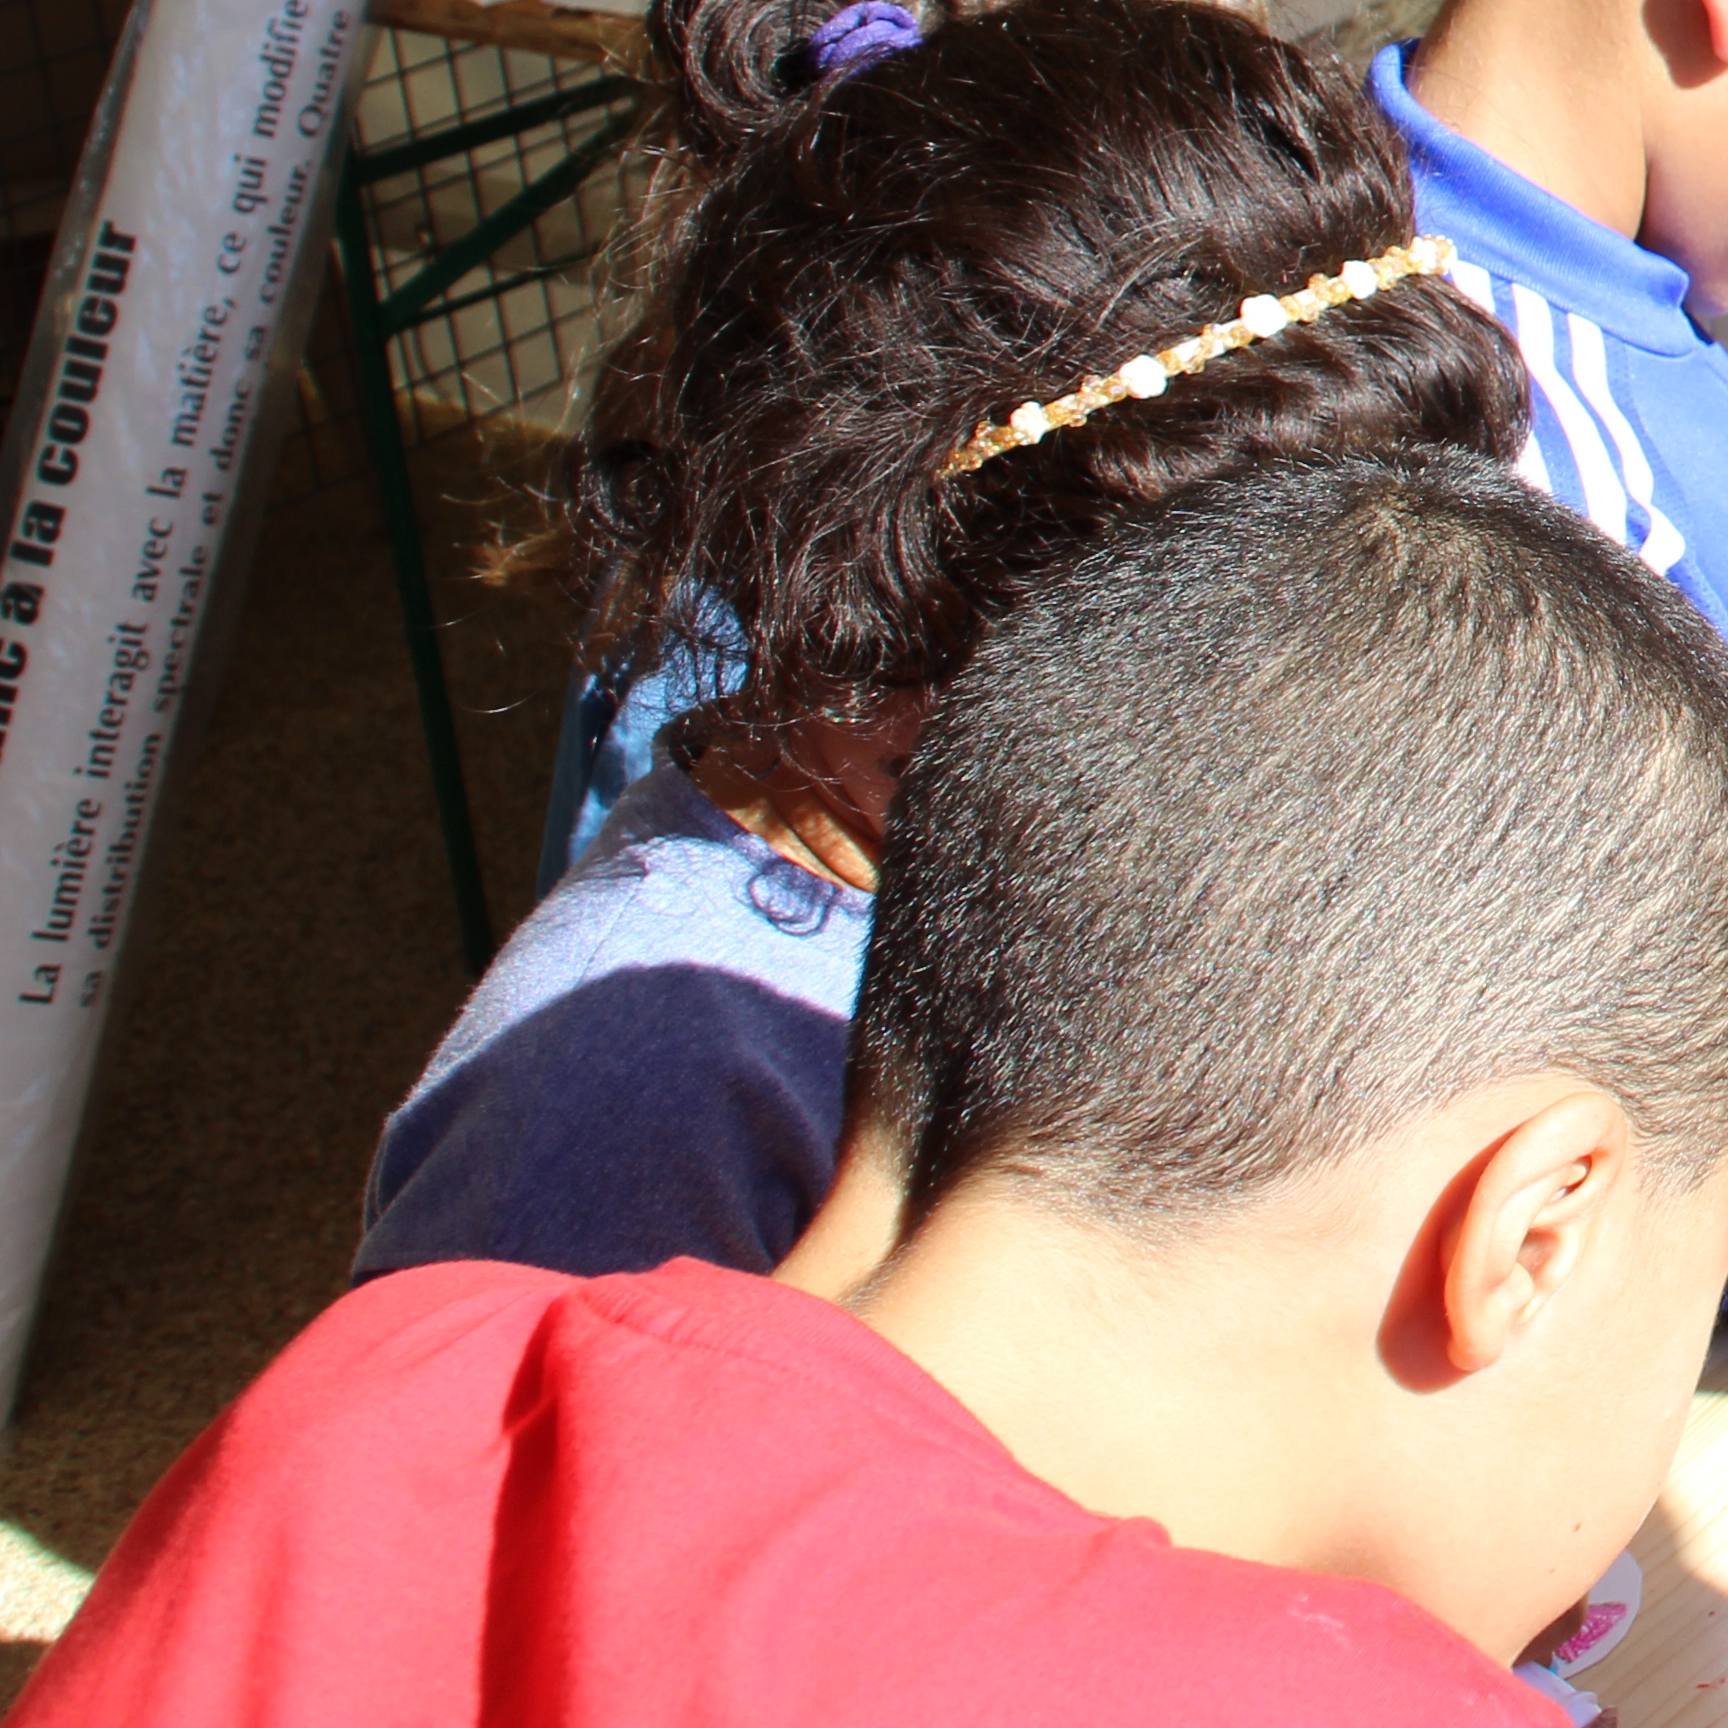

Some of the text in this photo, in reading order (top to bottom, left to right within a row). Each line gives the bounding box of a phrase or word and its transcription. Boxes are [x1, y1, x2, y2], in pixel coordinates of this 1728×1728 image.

[232, 153, 268, 214] qui
[216, 232, 246, 274] ce
[37, 219, 139, 488] couleur
[171, 297, 237, 446] matière,
[79, 10, 348, 1010] sa distribution spectrale et donc sa couleur. Quatre
[145, 466, 188, 499] la
[9, 499, 67, 570] la
[131, 519, 173, 603] avec
[74, 620, 150, 780] interagit
[31, 797, 102, 942] lumière
[18, 962, 62, 1006] La
